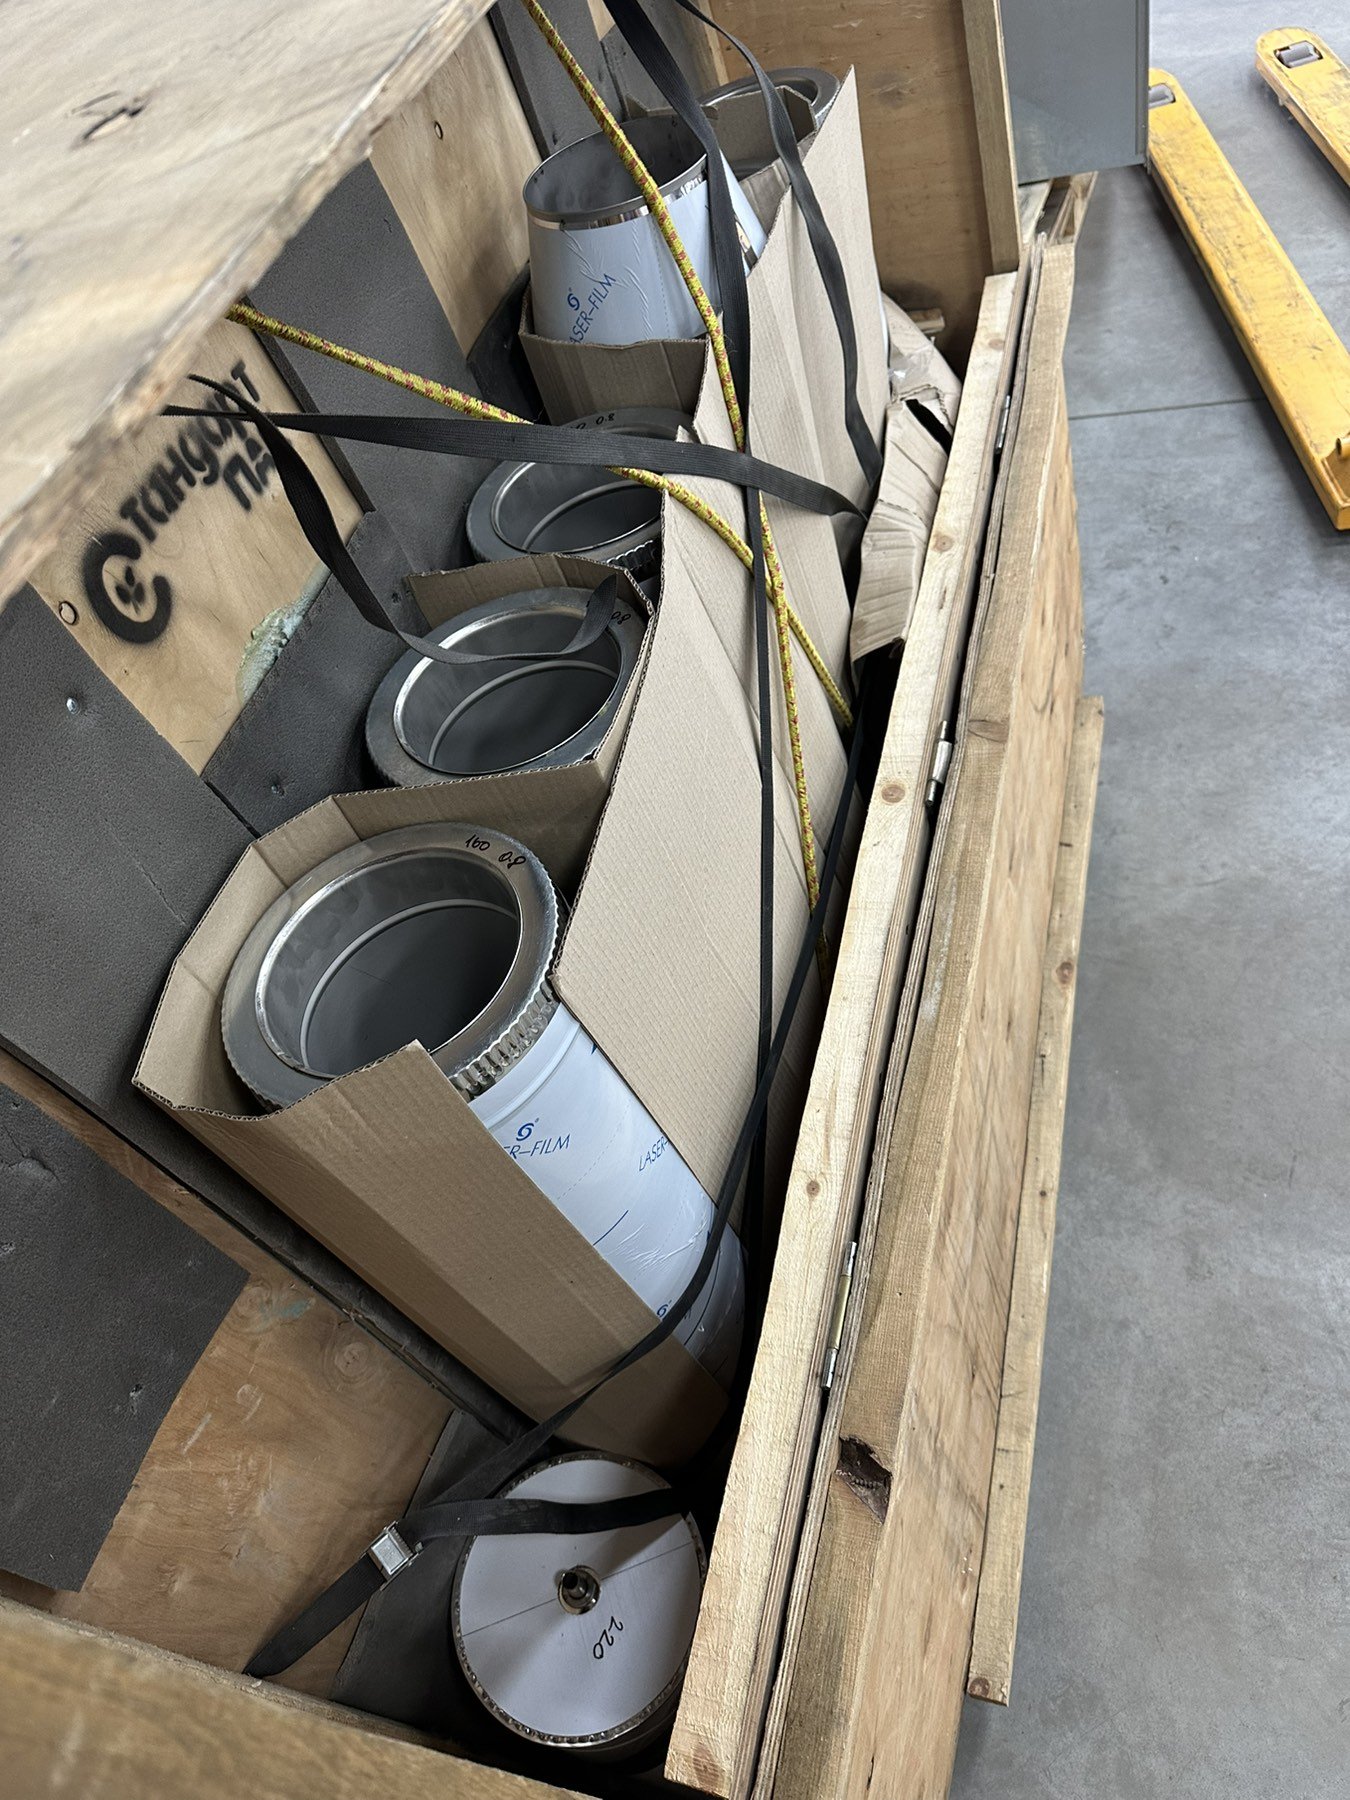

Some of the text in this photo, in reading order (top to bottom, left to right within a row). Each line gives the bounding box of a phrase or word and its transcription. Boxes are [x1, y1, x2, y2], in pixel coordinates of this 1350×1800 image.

[569, 273, 616, 344] ASER-FILM
[465, 834, 490, 851] 160
[638, 1135, 669, 1172] LASER-
[593, 1615, 624, 1660] 220
